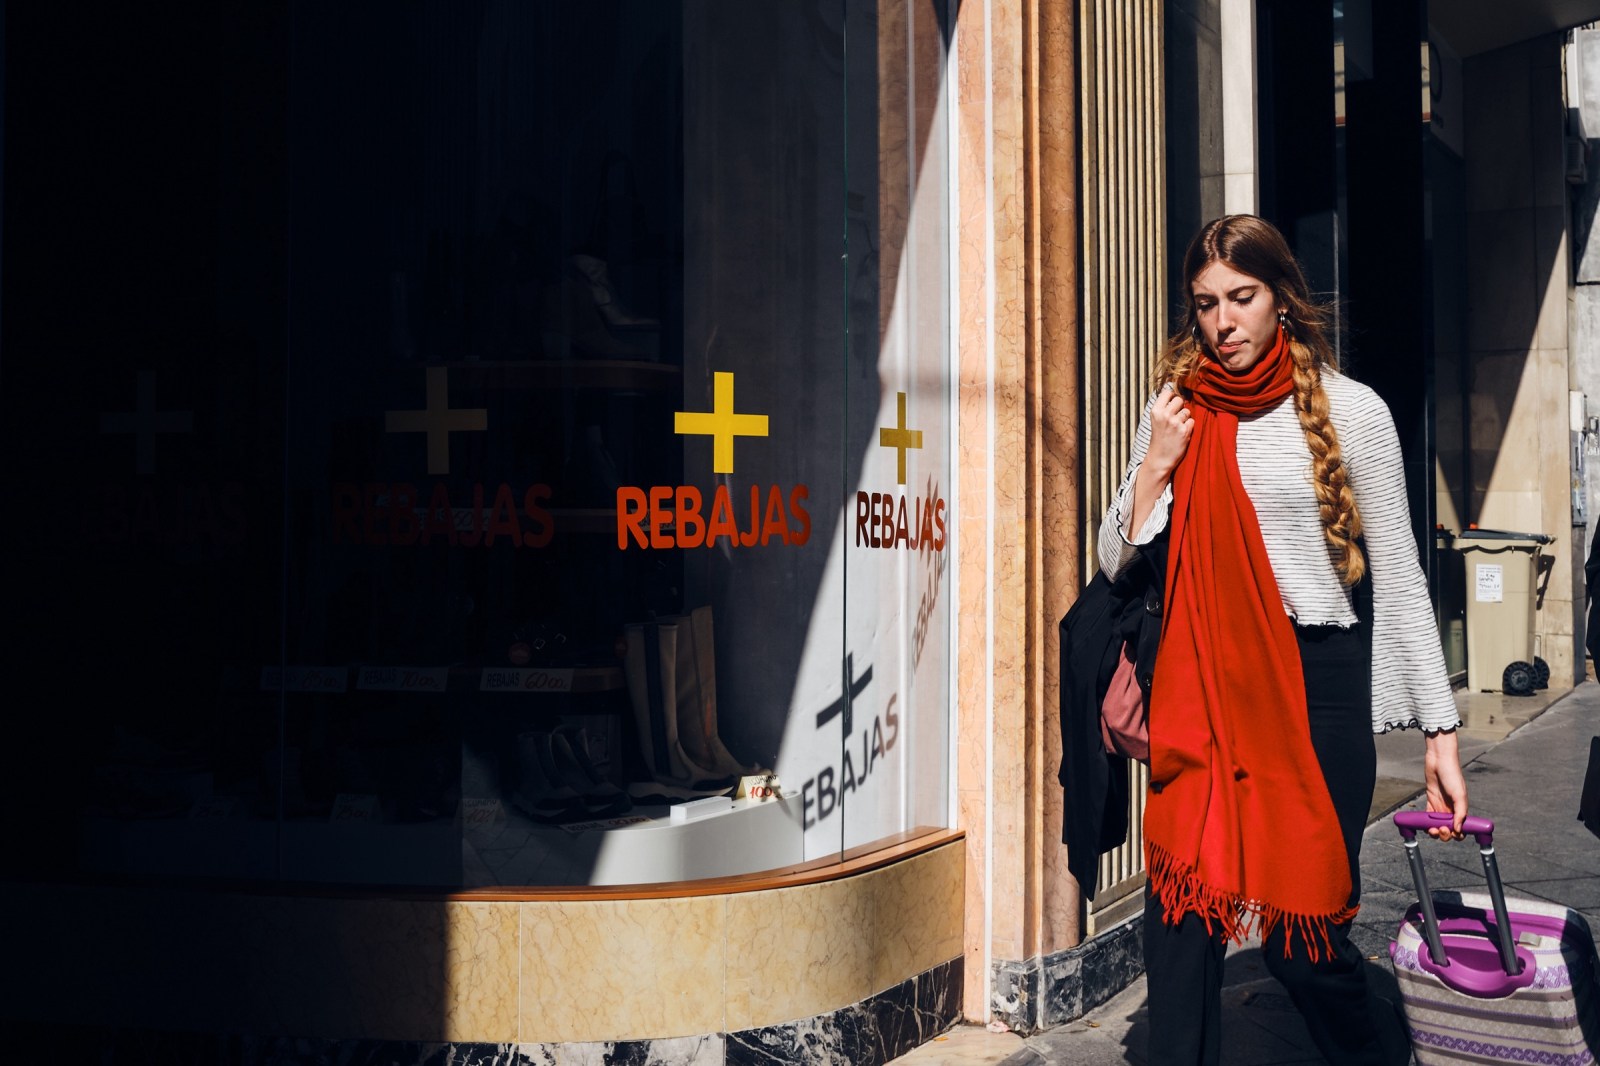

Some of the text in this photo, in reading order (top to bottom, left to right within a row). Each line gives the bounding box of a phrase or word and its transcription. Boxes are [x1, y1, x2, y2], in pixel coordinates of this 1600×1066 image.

[332, 480, 554, 548] REBAJAS
[616, 484, 811, 550] REBAJAS
[856, 490, 946, 552] REBAJAS
[486, 671, 520, 688] REBAJAS
